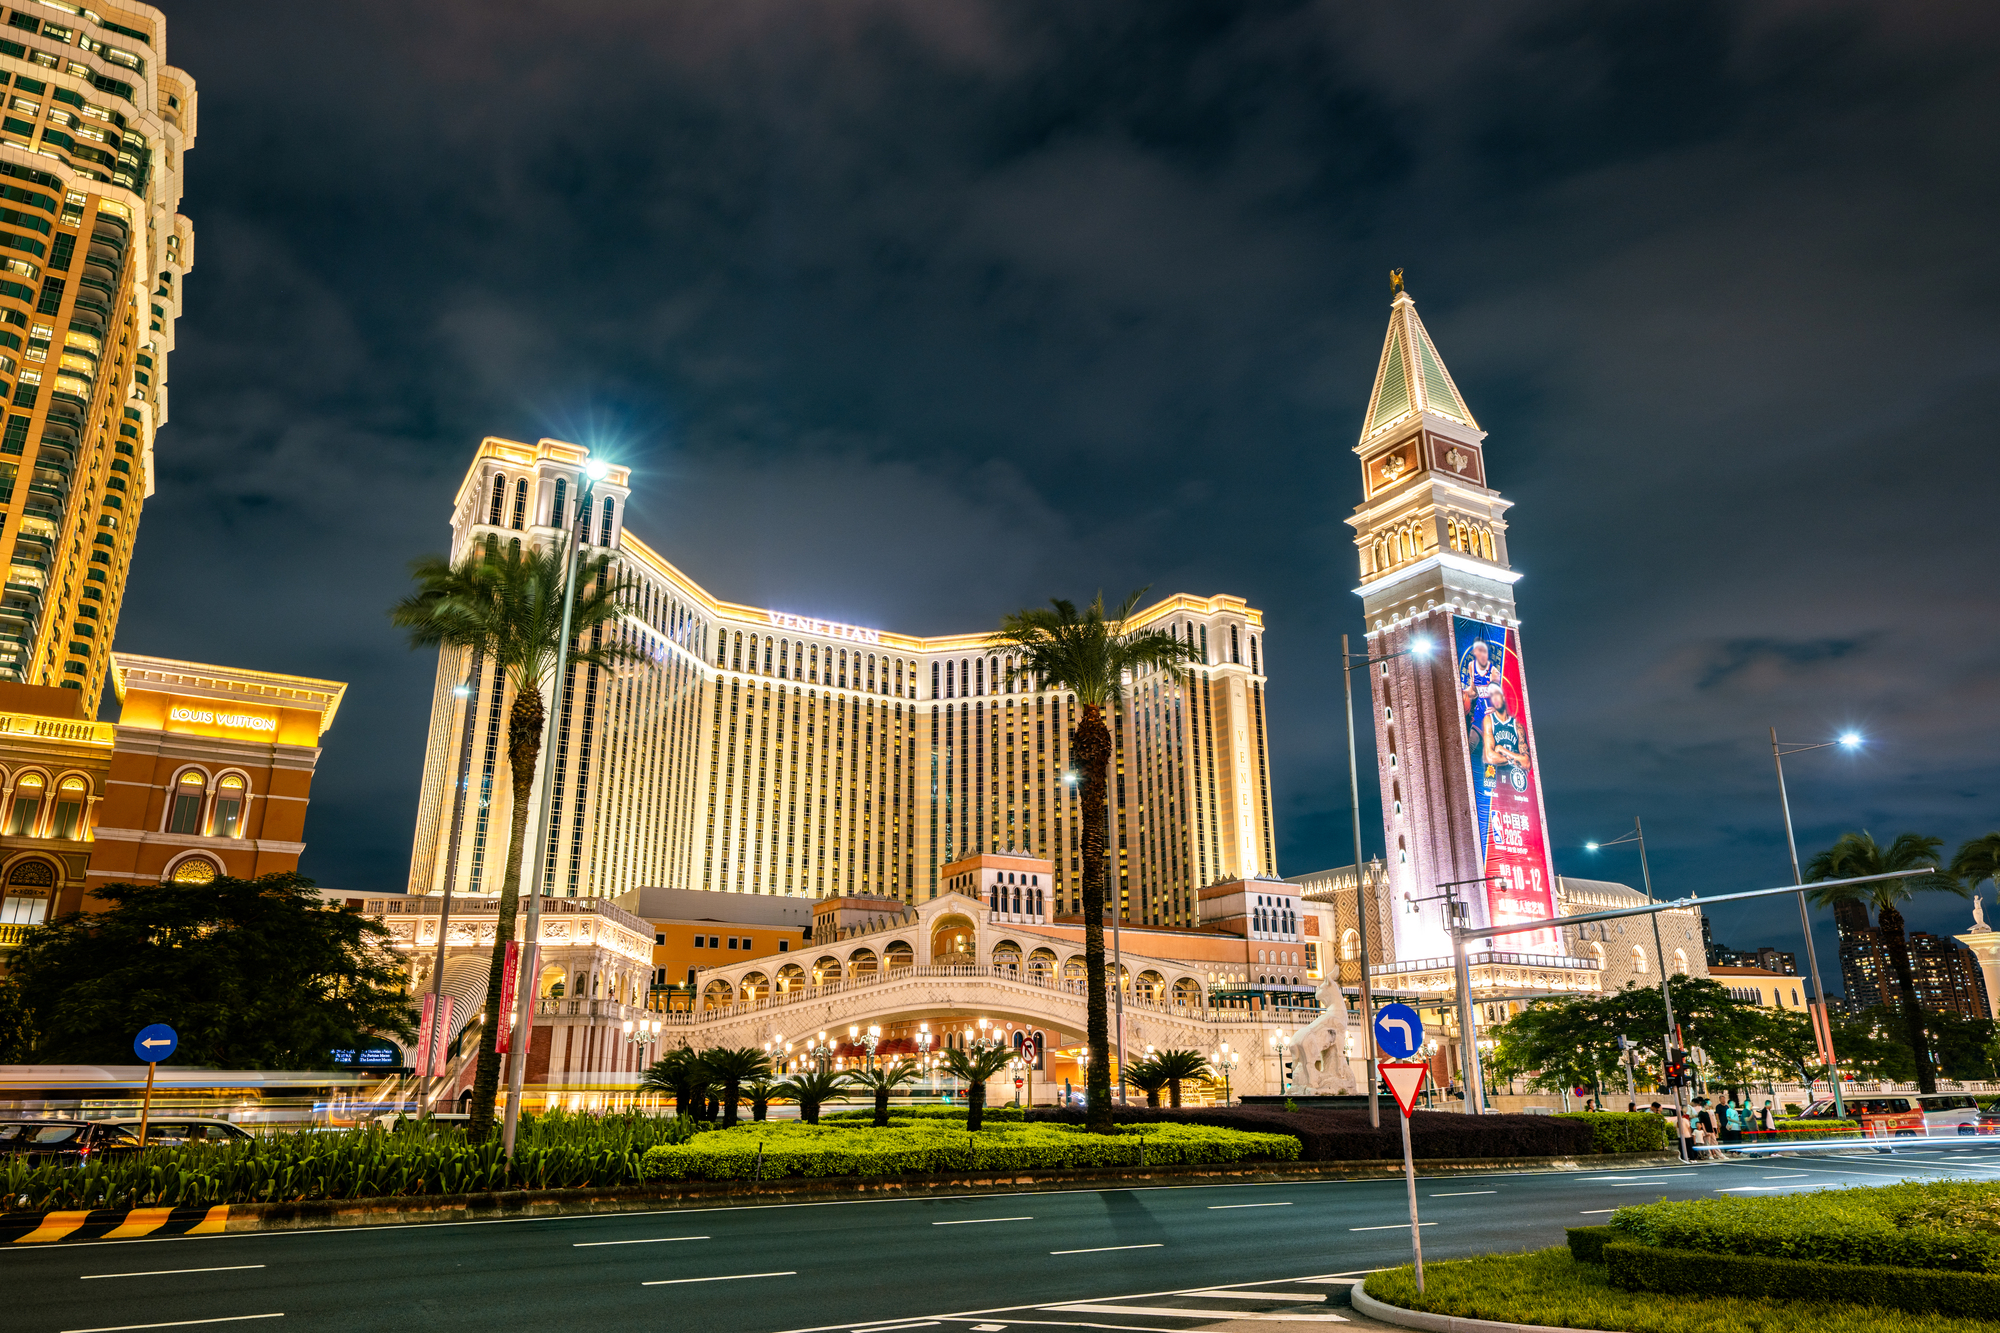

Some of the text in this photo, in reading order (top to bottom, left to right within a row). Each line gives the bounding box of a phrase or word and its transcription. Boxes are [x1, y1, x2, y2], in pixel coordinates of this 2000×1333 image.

[768, 610, 880, 643] VENETIAN
[172, 708, 275, 729] LOUIS VUITTON
[1495, 731, 1517, 745] BROOKLYN
[1238, 730, 1253, 871] VENETIA
[1503, 813, 1529, 831] 中国赛
[1505, 830, 1523, 846] 2025
